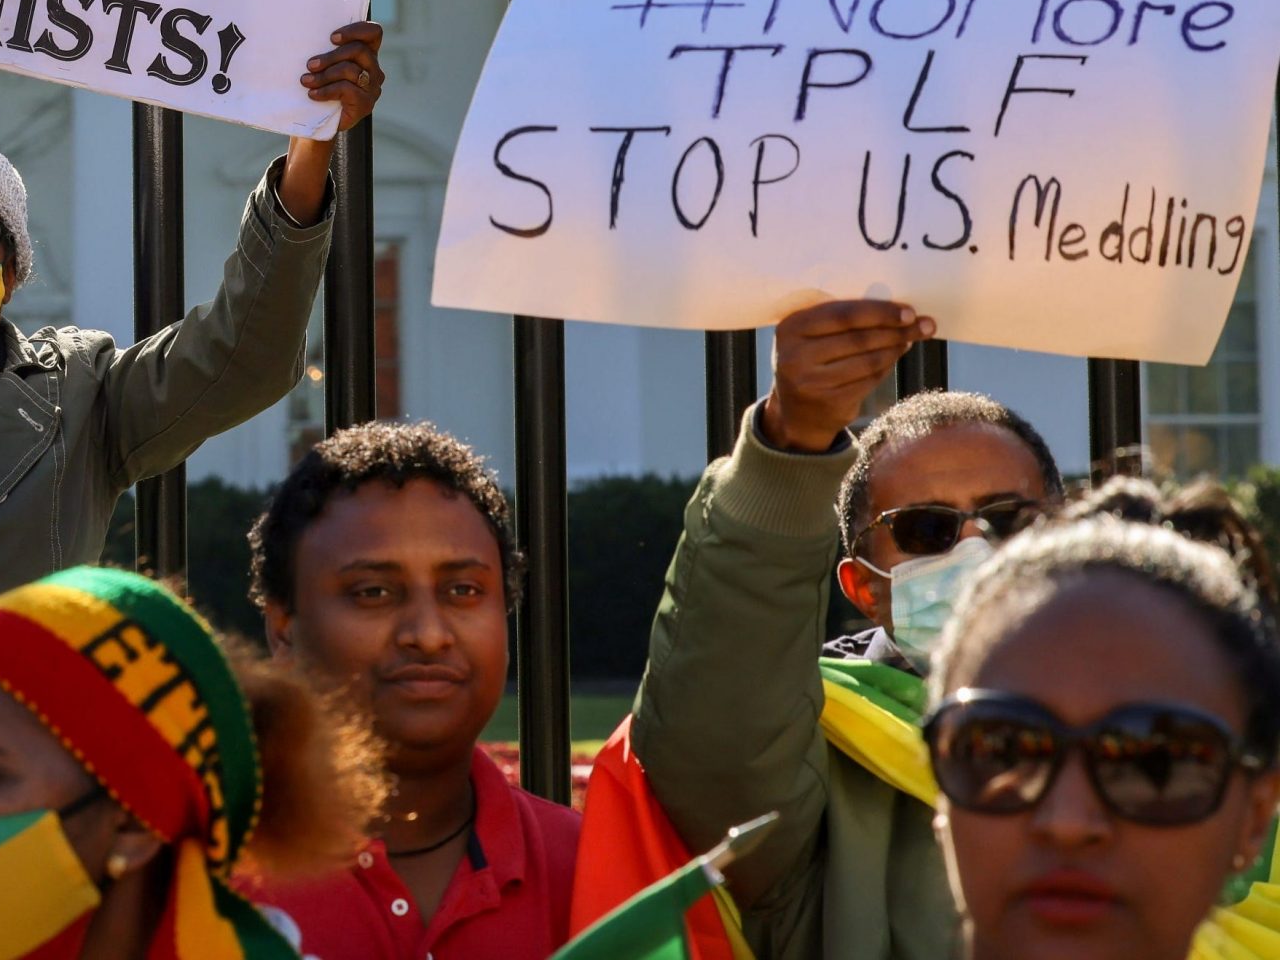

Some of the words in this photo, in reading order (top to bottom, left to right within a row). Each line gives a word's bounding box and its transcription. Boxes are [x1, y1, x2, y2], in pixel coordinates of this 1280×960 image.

[668, 44, 1089, 138] TPLF
[489, 125, 801, 239] STOP
[857, 149, 980, 255] U.S.
[1008, 173, 1246, 276] Meddling
